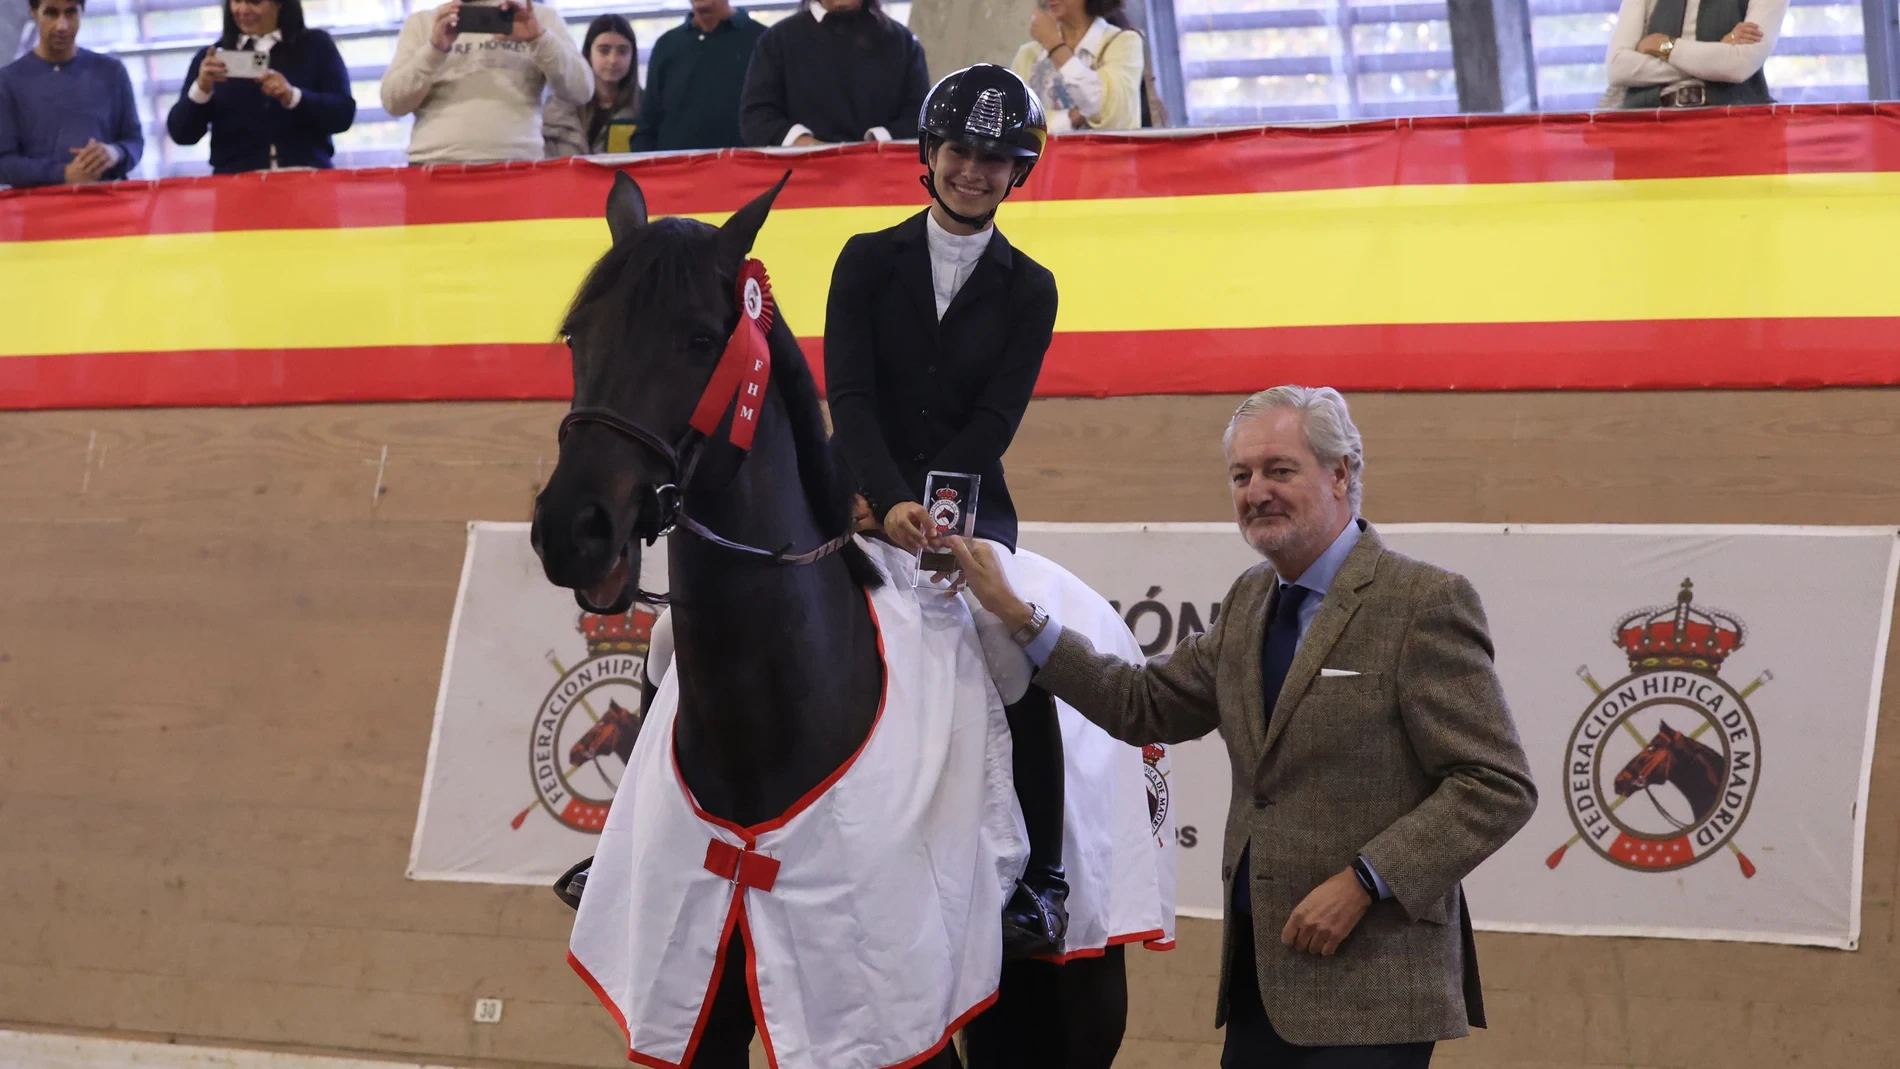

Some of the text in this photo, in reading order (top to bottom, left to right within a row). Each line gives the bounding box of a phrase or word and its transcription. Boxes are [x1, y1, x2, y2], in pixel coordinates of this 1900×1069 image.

[1108, 585, 1222, 657] ÓN
[537, 658, 644, 805] FEDERACION HIPI
[1573, 675, 1751, 847] FEDERACION HIPICA DE MADRID
[1156, 781, 1165, 795] DE
